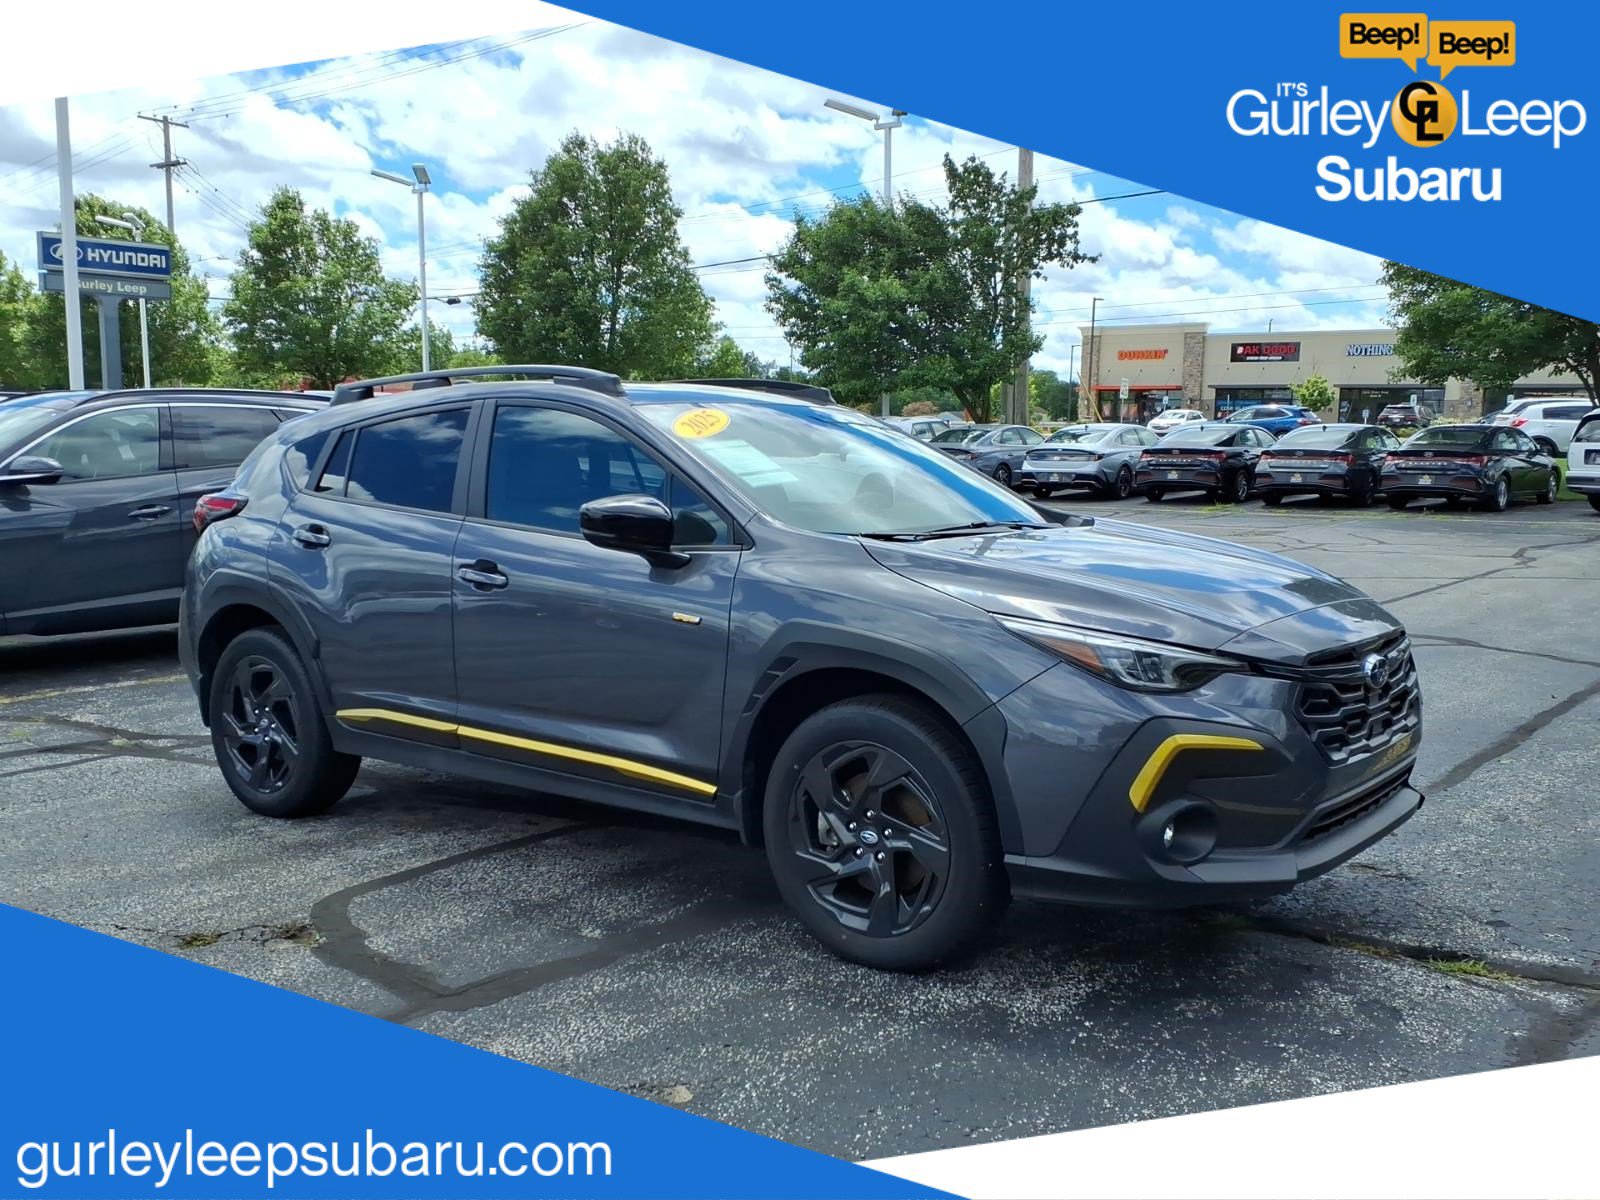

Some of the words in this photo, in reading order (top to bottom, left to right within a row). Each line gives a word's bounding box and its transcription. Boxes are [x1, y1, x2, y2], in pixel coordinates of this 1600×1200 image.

[87, 248, 166, 268] HYUNDAI
[78, 280, 113, 293] urley
[117, 281, 147, 295] Leep
[1345, 344, 1394, 356] NOTHING
[681, 410, 721, 436] 2025
